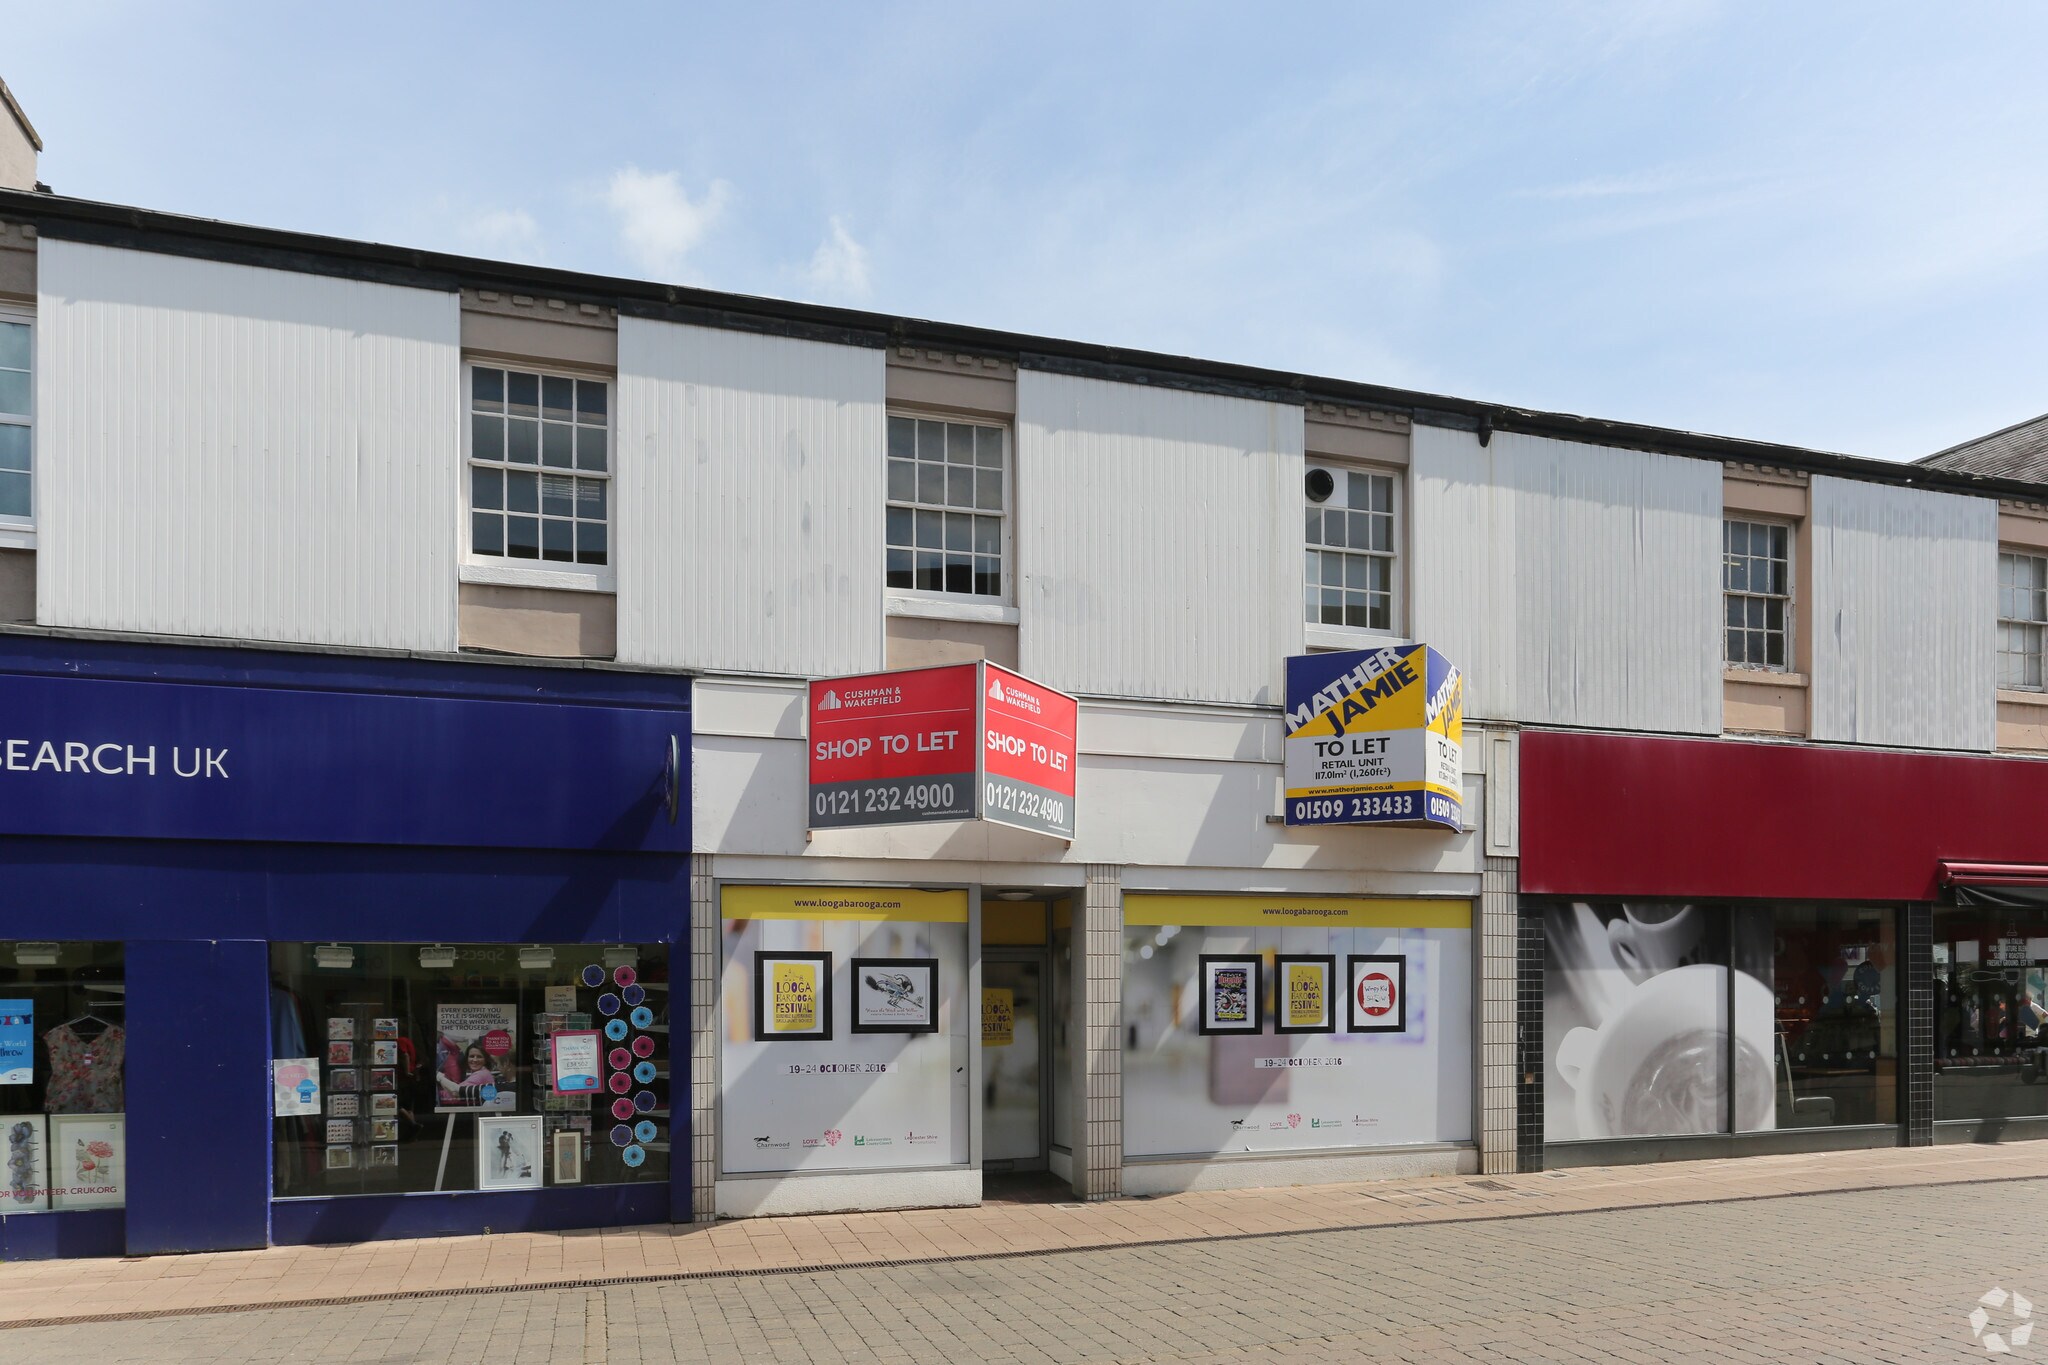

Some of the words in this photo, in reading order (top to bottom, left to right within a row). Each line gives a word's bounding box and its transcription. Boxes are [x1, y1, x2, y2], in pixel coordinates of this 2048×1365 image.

[844, 688, 893, 699] CUSHMAN
[895, 686, 901, 696] &
[1005, 686, 1035, 704] CUSHMAN
[1035, 697, 1040, 706] &
[1286, 646, 1403, 733] MATHER
[844, 695, 901, 708] WAKEFIELD
[1005, 694, 1041, 715] WAKEFIELD
[1326, 660, 1419, 738] JAMIE
[815, 737, 871, 760] SHOP
[879, 734, 909, 755] TO
[917, 730, 959, 752] LET
[987, 730, 1026, 757] SHOP
[1030, 742, 1047, 764] TO
[1050, 749, 1068, 772] LET
[1314, 741, 1345, 758] TO
[1352, 737, 1391, 755] LET
[0, 739, 156, 776] EARCH
[173, 746, 229, 779] UK
[1437, 740, 1448, 759] TO
[1449, 745, 1458, 765] LET
[1321, 759, 1355, 770] RETAIL
[1358, 757, 1384, 768] UNIT
[1308, 783, 1395, 796] www.matherjamie.co.uk
[815, 789, 859, 816] 0121
[865, 786, 901, 812] 232
[904, 783, 955, 809] 4900
[987, 782, 1017, 811] 0121
[1018, 790, 1040, 818] 232
[1040, 797, 1064, 824] 4900
[1295, 799, 1344, 821] 01509
[1351, 796, 1413, 817] 233433
[1431, 797, 1450, 819] 01509
[794, 899, 901, 910] www.loogabarooga.com
[1262, 907, 1349, 917] www.loogabarooga.com
[776, 981, 813, 993] LOOGA
[1291, 981, 1320, 992] LOOGA
[776, 994, 813, 1002] BAROOGA
[1291, 992, 1320, 1000] BAROOGA
[776, 1003, 813, 1013] FESTIVAL
[1291, 1000, 1320, 1010] FESTIVAL
[789, 1064, 817, 1074] 19-24
[820, 1063, 861, 1073] OCTOBER
[864, 1063, 886, 1073] 2016
[1264, 1059, 1287, 1067] 19-24
[1288, 1058, 1323, 1067] OCTOBER
[1325, 1058, 1342, 1066] 2016
